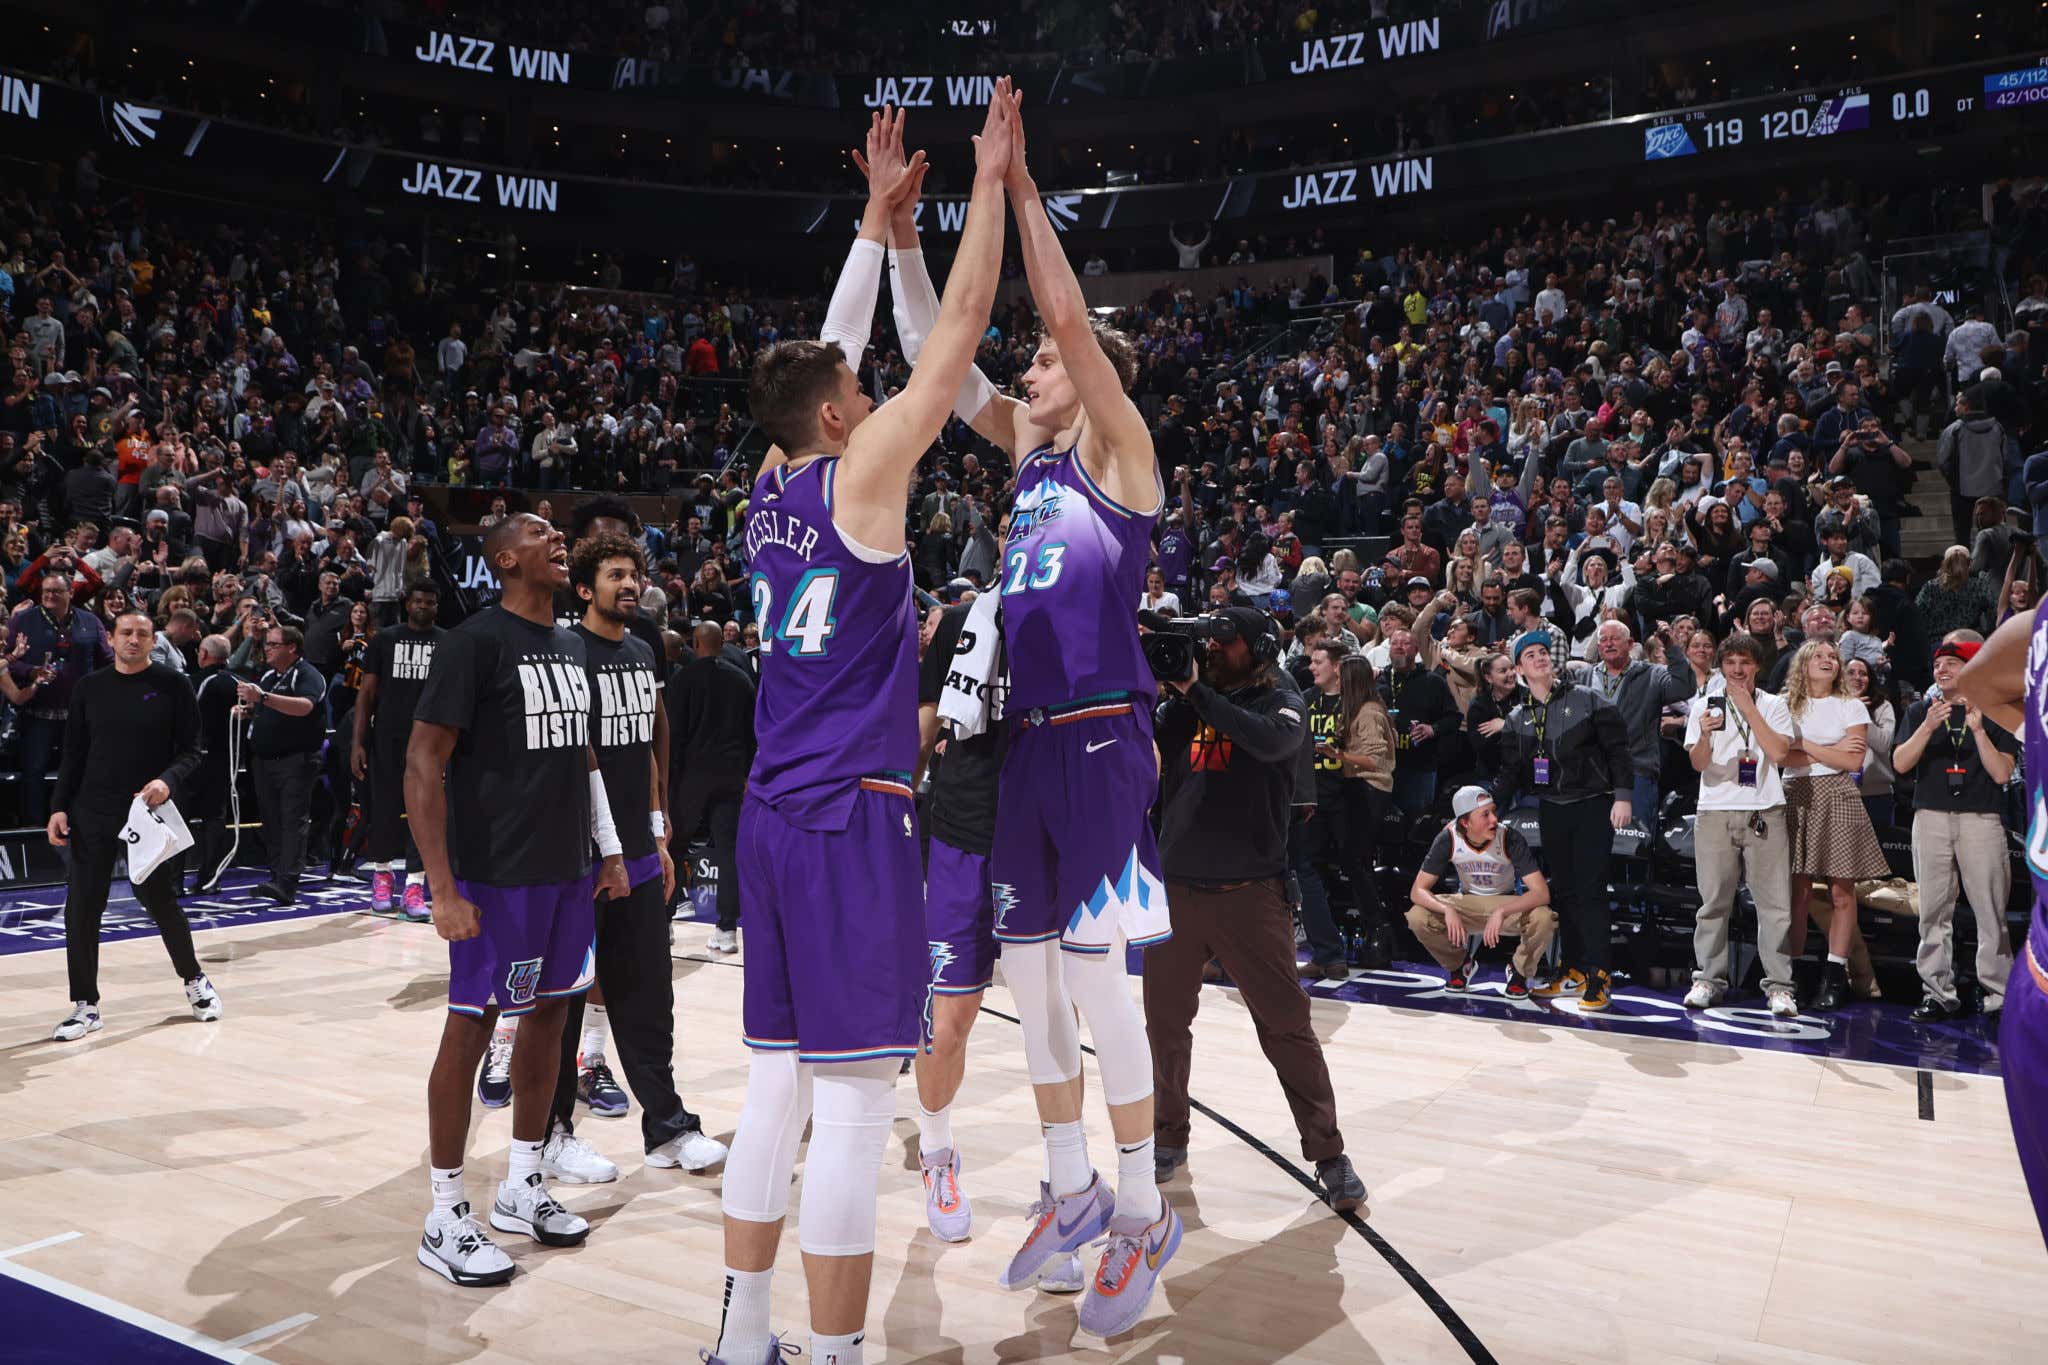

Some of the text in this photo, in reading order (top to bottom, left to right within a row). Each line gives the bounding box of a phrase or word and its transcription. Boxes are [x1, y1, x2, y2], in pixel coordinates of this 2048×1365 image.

[415, 30, 495, 73] JAZZ
[508, 45, 569, 83] WIN
[1290, 32, 1365, 74] JAZZ
[1378, 17, 1440, 59] WIN
[0, 75, 40, 119] IN
[864, 77, 934, 107] JAZZ
[1892, 88, 1930, 121] 0.0
[1956, 97, 1975, 112] OT
[1703, 118, 1743, 148] 119
[1760, 108, 1809, 140] 120
[402, 162, 558, 212] JAZZ WIN
[1283, 157, 1433, 209] JAZZ WIN
[452, 555, 502, 590] JA
[1002, 542, 1068, 597] 23
[751, 566, 840, 658] 24
[393, 643, 433, 666] BLAC
[697, 857, 719, 880] Sn
